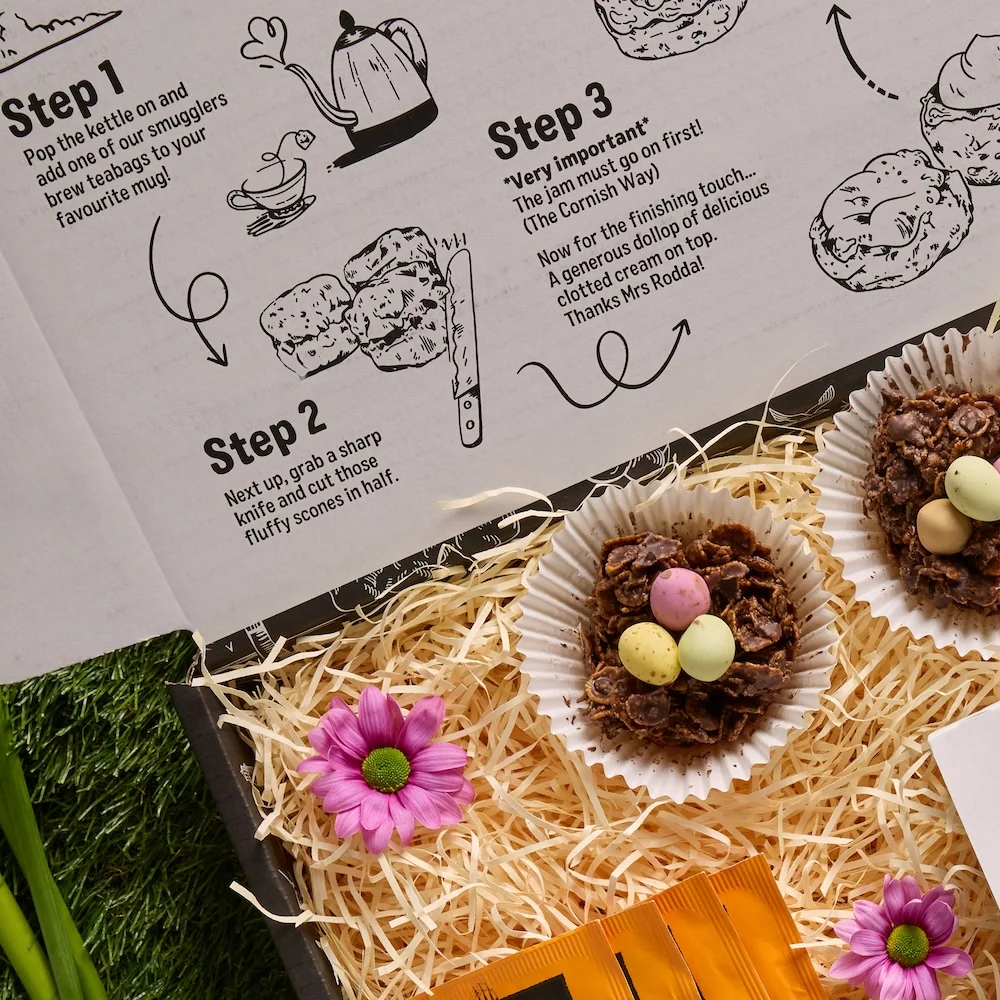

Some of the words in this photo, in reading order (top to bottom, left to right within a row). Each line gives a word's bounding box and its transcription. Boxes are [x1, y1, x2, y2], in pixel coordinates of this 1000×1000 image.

[1, 79, 98, 138] Step
[98, 59, 124, 95] 1
[23, 144, 56, 166] Pop
[56, 131, 85, 152] the
[84, 109, 134, 139] kettle
[136, 100, 157, 117] on
[158, 81, 189, 107] and
[488, 103, 583, 160] Step
[585, 82, 613, 119] 3
[36, 161, 67, 187] add
[68, 152, 97, 173] one
[98, 138, 116, 159] of
[119, 129, 144, 150] our
[147, 93, 228, 137] smugglers
[44, 181, 85, 208] brew
[86, 153, 151, 189] teabags
[151, 145, 170, 161] to
[171, 127, 206, 156] your
[512, 193, 543, 213] The
[543, 179, 576, 205] jam
[576, 158, 618, 187] must
[619, 152, 639, 172] go
[641, 141, 661, 158] on
[662, 118, 704, 149] first!
[56, 188, 130, 228] favourite
[131, 165, 171, 196] mug!
[523, 211, 558, 235] (The
[558, 183, 619, 218] Cornish
[617, 162, 659, 192] Way)
[537, 244, 571, 268] Now
[573, 232, 597, 252] for
[600, 221, 627, 240] the
[628, 190, 698, 228] finishing
[698, 168, 756, 197] touch...
[548, 271, 561, 288] A
[562, 243, 631, 285] generous
[633, 222, 680, 250] dollop
[682, 208, 699, 229] of
[702, 182, 770, 220] delicious
[557, 271, 613, 307] clotted
[614, 253, 663, 282] cream
[664, 244, 685, 261] on
[685, 232, 718, 251] top.
[563, 295, 621, 327] Thanks
[620, 283, 650, 303] Mrs
[649, 255, 705, 291] Rodda!
[203, 420, 297, 475] Step
[298, 399, 327, 435] 2
[224, 481, 263, 507] Next
[263, 474, 289, 491] up,
[289, 454, 324, 483] grab
[326, 451, 338, 463] a
[338, 431, 382, 458] sharp
[233, 500, 276, 527] knife
[277, 484, 307, 508] and
[308, 473, 335, 495] cut
[335, 456, 378, 482] those
[245, 517, 291, 546] fluffy
[293, 494, 344, 525] scones
[346, 487, 362, 502] in
[360, 468, 399, 495] half.
